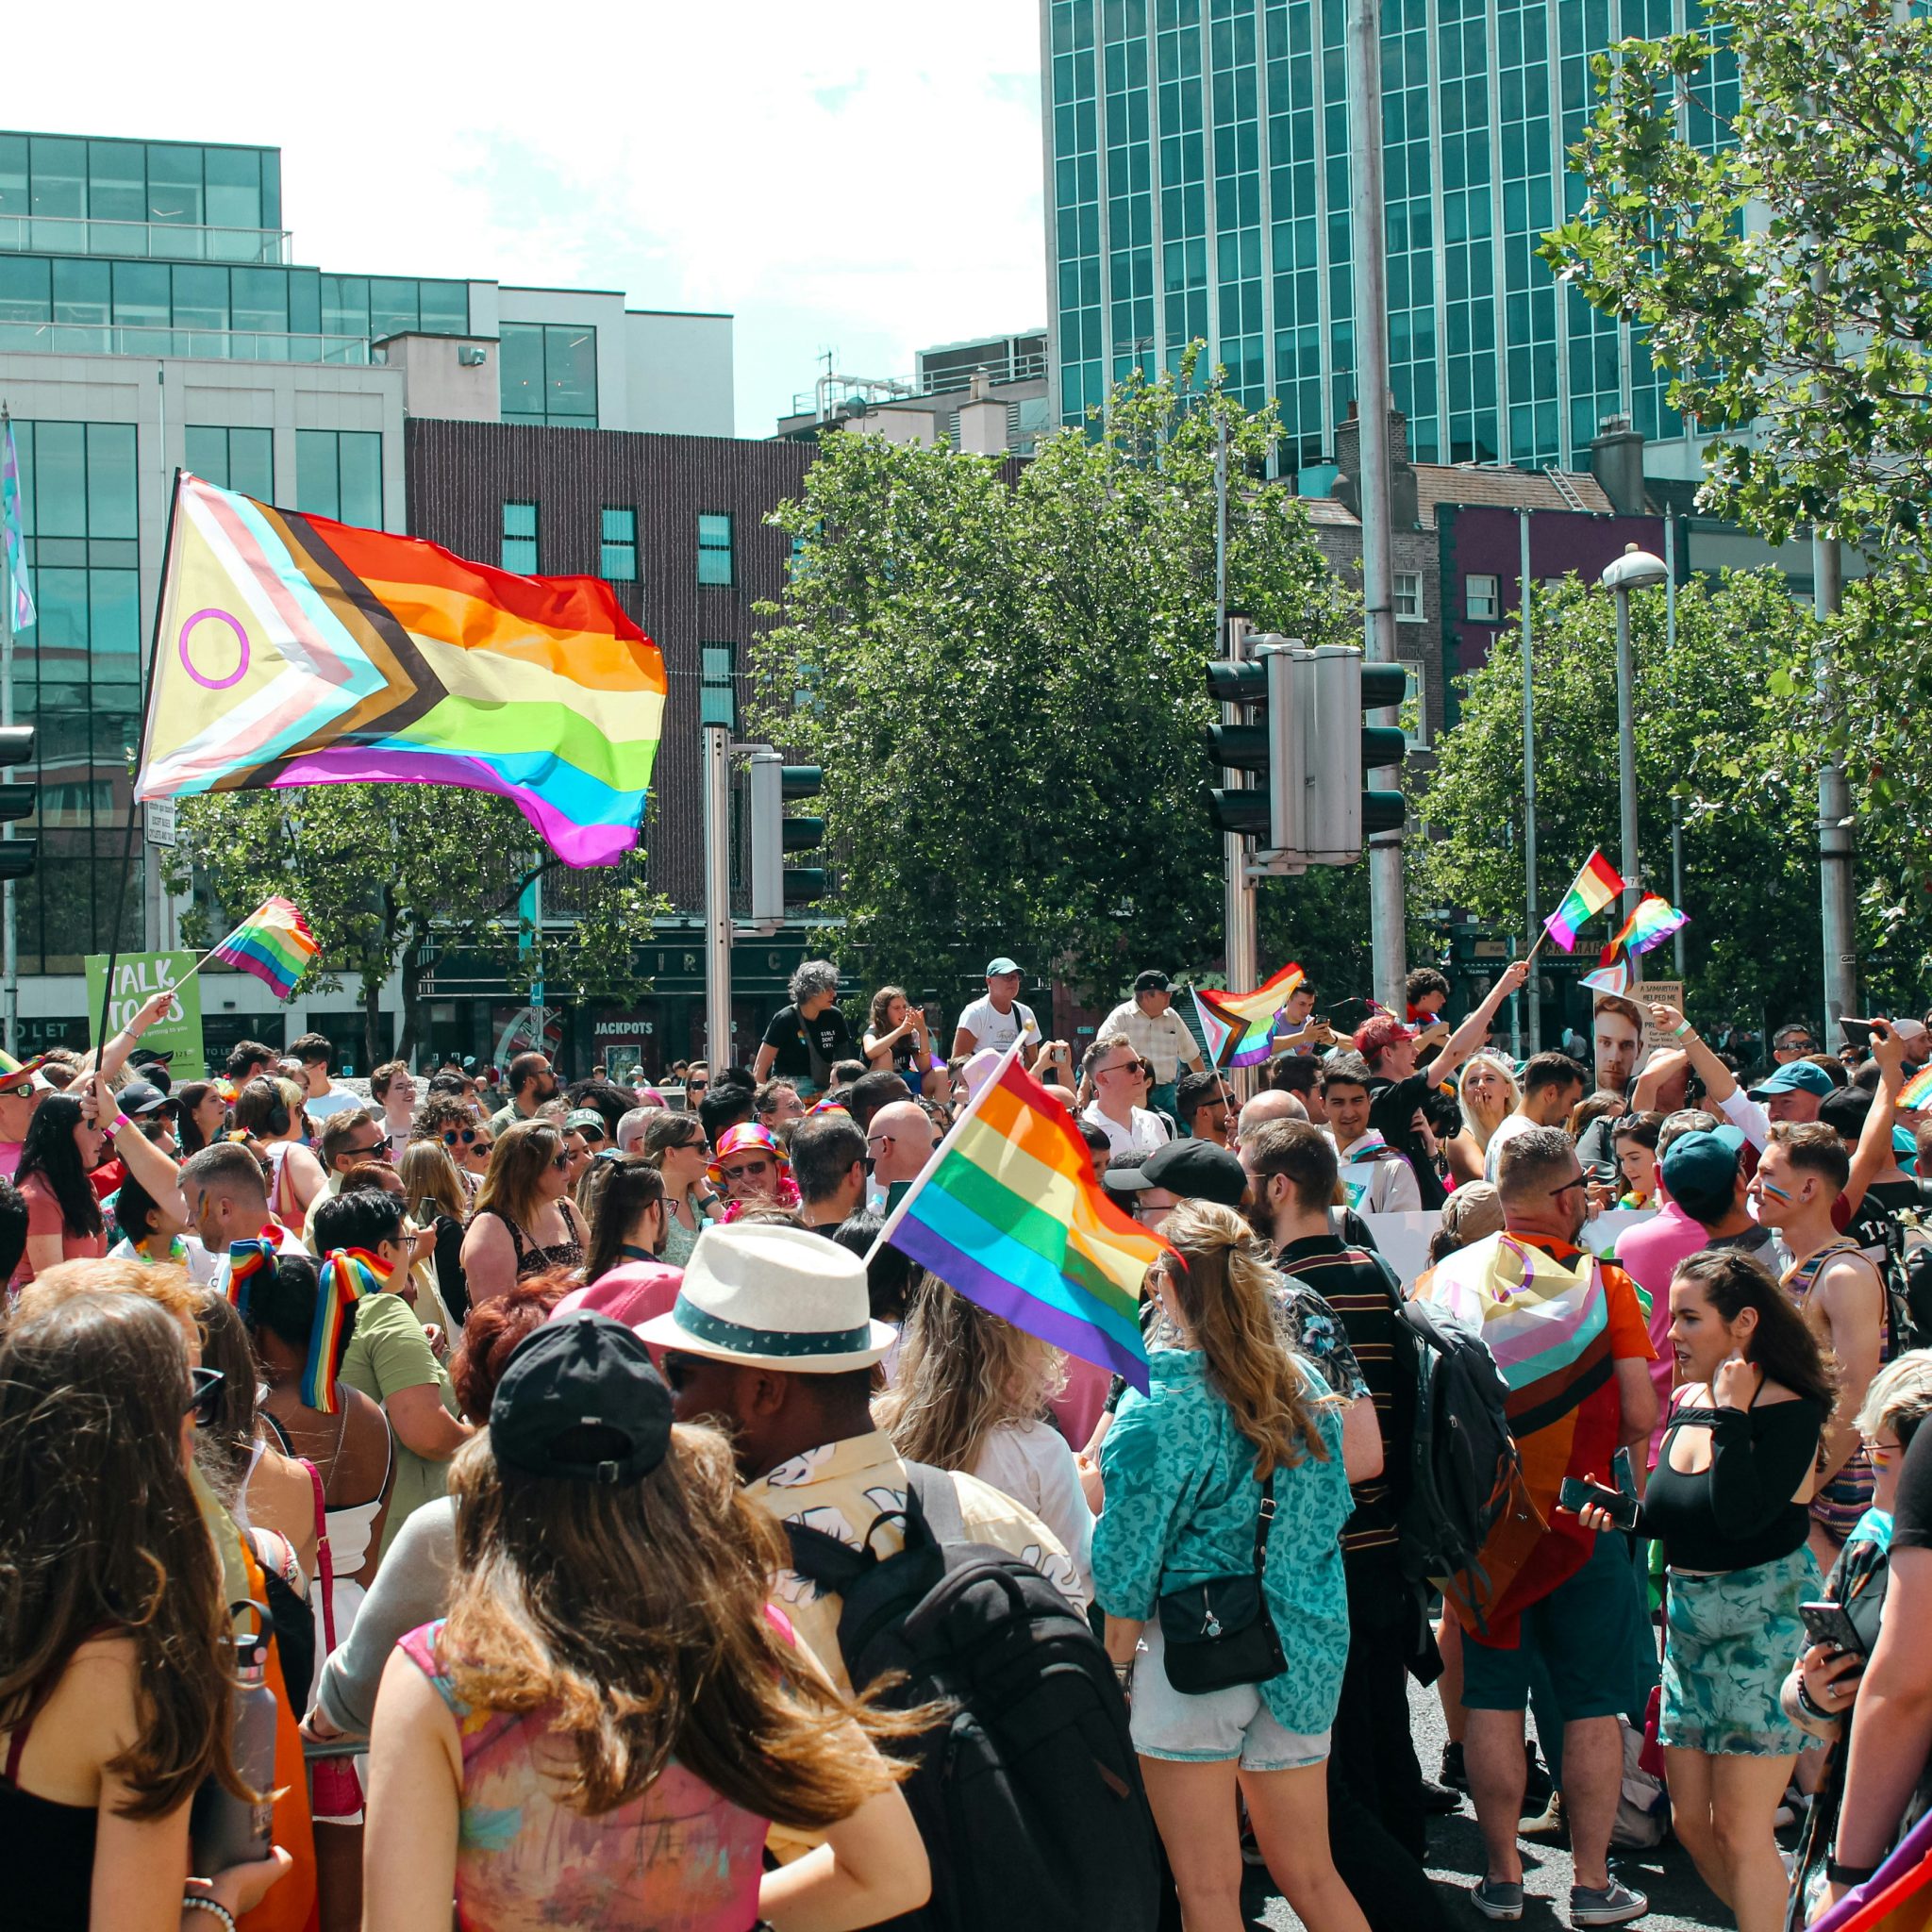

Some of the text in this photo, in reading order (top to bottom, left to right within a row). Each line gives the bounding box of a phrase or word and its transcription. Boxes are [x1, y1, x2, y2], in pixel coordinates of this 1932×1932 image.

[102, 958, 175, 996] TALK
[108, 998, 141, 1032] TO
[32, 1023, 68, 1038] LET
[594, 1022, 653, 1035] JACKPOTS
